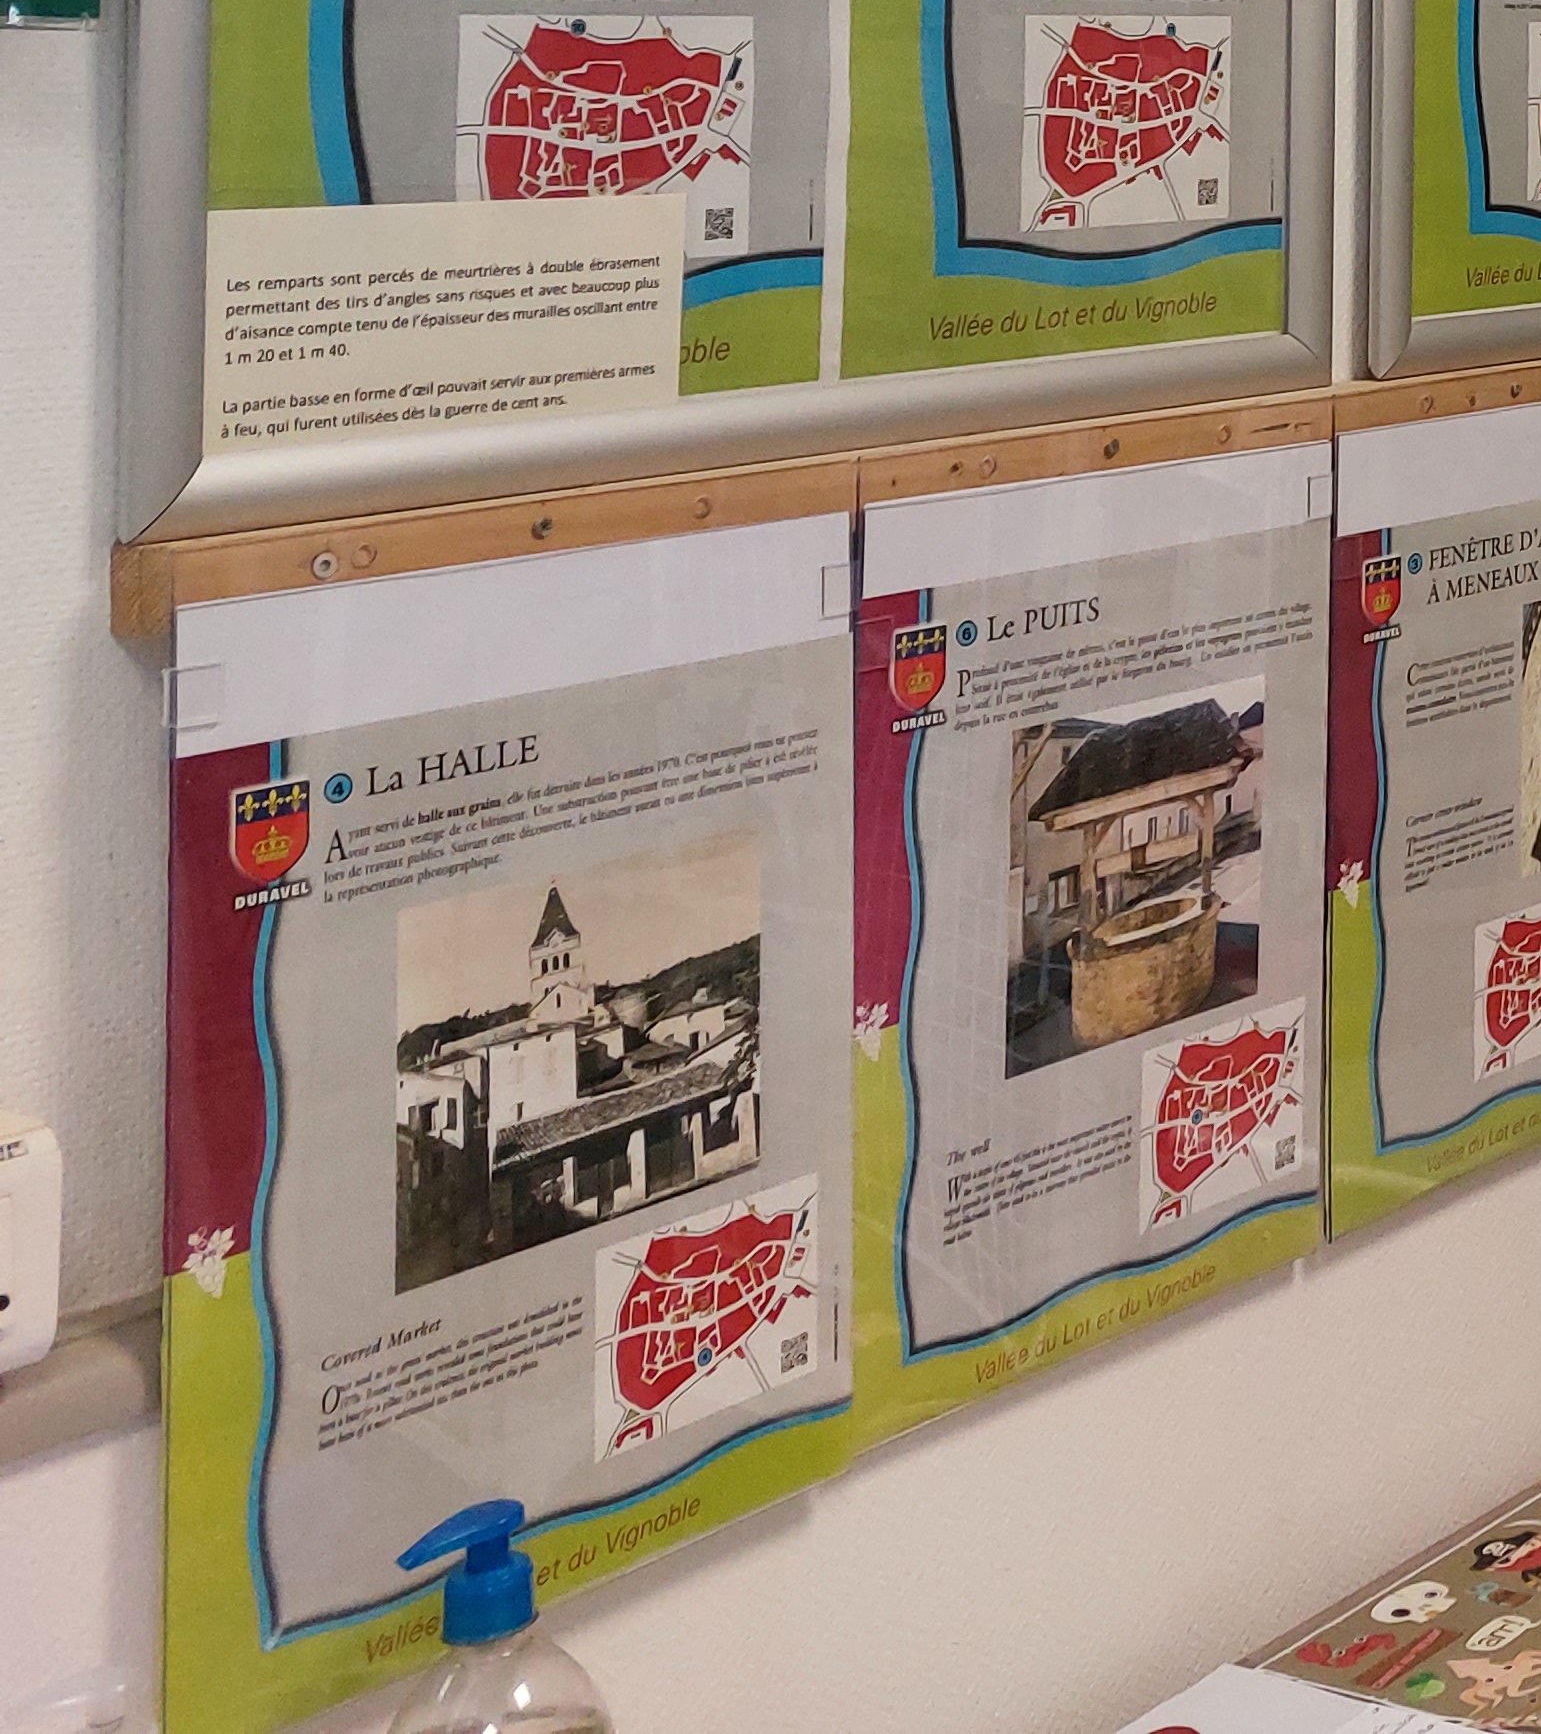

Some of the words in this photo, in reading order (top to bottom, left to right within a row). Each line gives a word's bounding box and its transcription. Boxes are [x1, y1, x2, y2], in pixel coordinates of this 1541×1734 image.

[227, 278, 250, 292] Les
[257, 274, 324, 291] remparts
[330, 273, 361, 286] sont
[368, 268, 414, 286] percés
[421, 267, 438, 281] de
[444, 263, 521, 280] meurtrières
[526, 262, 534, 275] à
[540, 259, 584, 274] double
[589, 256, 661, 271] ébrasement
[225, 299, 310, 319] permettant
[315, 296, 340, 310] des
[346, 296, 369, 309] tirs
[373, 292, 431, 308] d'angles
[436, 290, 465, 304] sans
[469, 287, 516, 302] risques
[520, 286, 534, 298] et
[538, 284, 568, 296] avec
[571, 279, 631, 295] beaucoup
[634, 277, 660, 292] plus
[225, 325, 295, 341] d'aisance
[297, 320, 353, 336] compte
[356, 318, 387, 331] tenu
[391, 315, 409, 329] de
[412, 312, 484, 328] l'épaisseur
[487, 309, 509, 322] des
[512, 305, 571, 321] murailles
[574, 301, 623, 316] oscillant
[626, 299, 658, 312] entre
[930, 313, 993, 340] Vallée
[1001, 308, 1028, 333] du
[1035, 306, 1069, 330] Lot
[1076, 305, 1097, 326] et
[1102, 299, 1128, 324] du
[1135, 291, 1217, 322] Vignoble
[222, 400, 238, 414] La
[242, 396, 286, 415] partie
[289, 394, 330, 407] basse
[333, 392, 350, 403] en
[355, 387, 396, 402] forme
[437, 379, 487, 397] pouvait
[490, 375, 526, 389] servir
[528, 374, 551, 385] aux
[554, 368, 615, 387] premières
[618, 364, 656, 378] armes
[221, 425, 229, 439] à
[234, 422, 262, 438] feu,
[267, 420, 289, 437] qui
[294, 416, 338, 431] furent
[341, 411, 398, 426] utilisées
[402, 407, 425, 421] dès
[429, 405, 441, 418] la
[444, 403, 488, 420] guerre
[491, 399, 508, 412] de
[511, 396, 539, 410] cent
[542, 395, 568, 406] ans.
[1428, 533, 1514, 571] FENÊTRE
[1427, 578, 1440, 605] À
[1445, 560, 1540, 602] MENEAUX
[986, 614, 1015, 643] Le
[1022, 596, 1100, 635] PUITS
[891, 710, 947, 734] DURAVEL
[366, 766, 405, 796] La
[417, 734, 539, 786] HALLE
[235, 881, 310, 910] DURAVEL
[321, 1339, 383, 1375] Covered
[386, 1316, 442, 1350] Market
[536, 1559, 561, 1587] et
[568, 1542, 596, 1572] du
[604, 1496, 701, 1554] Vignoble
[365, 1615, 440, 1663] Vallée
